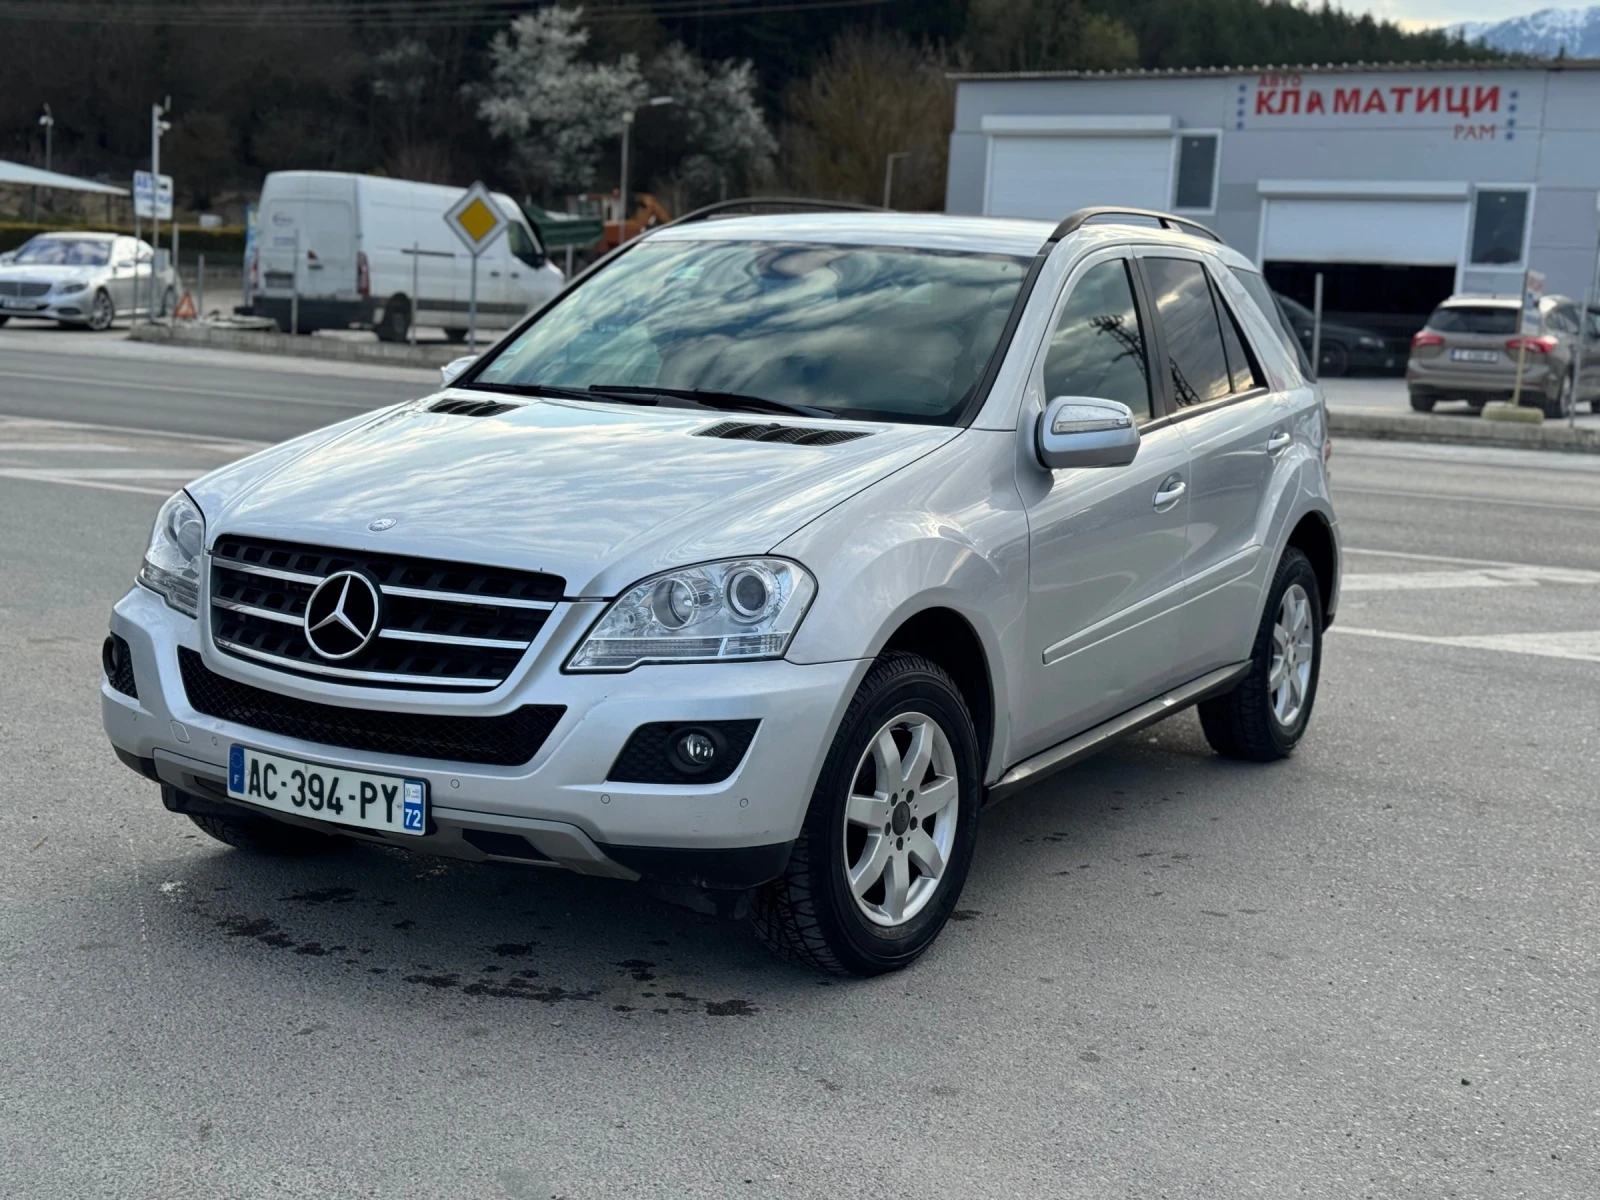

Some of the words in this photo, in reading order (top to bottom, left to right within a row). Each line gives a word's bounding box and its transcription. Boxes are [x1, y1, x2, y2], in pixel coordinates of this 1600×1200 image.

[1257, 74, 1302, 87] АВТО
[248, 758, 398, 823] AC-394-PY
[404, 808, 422, 828] 72
